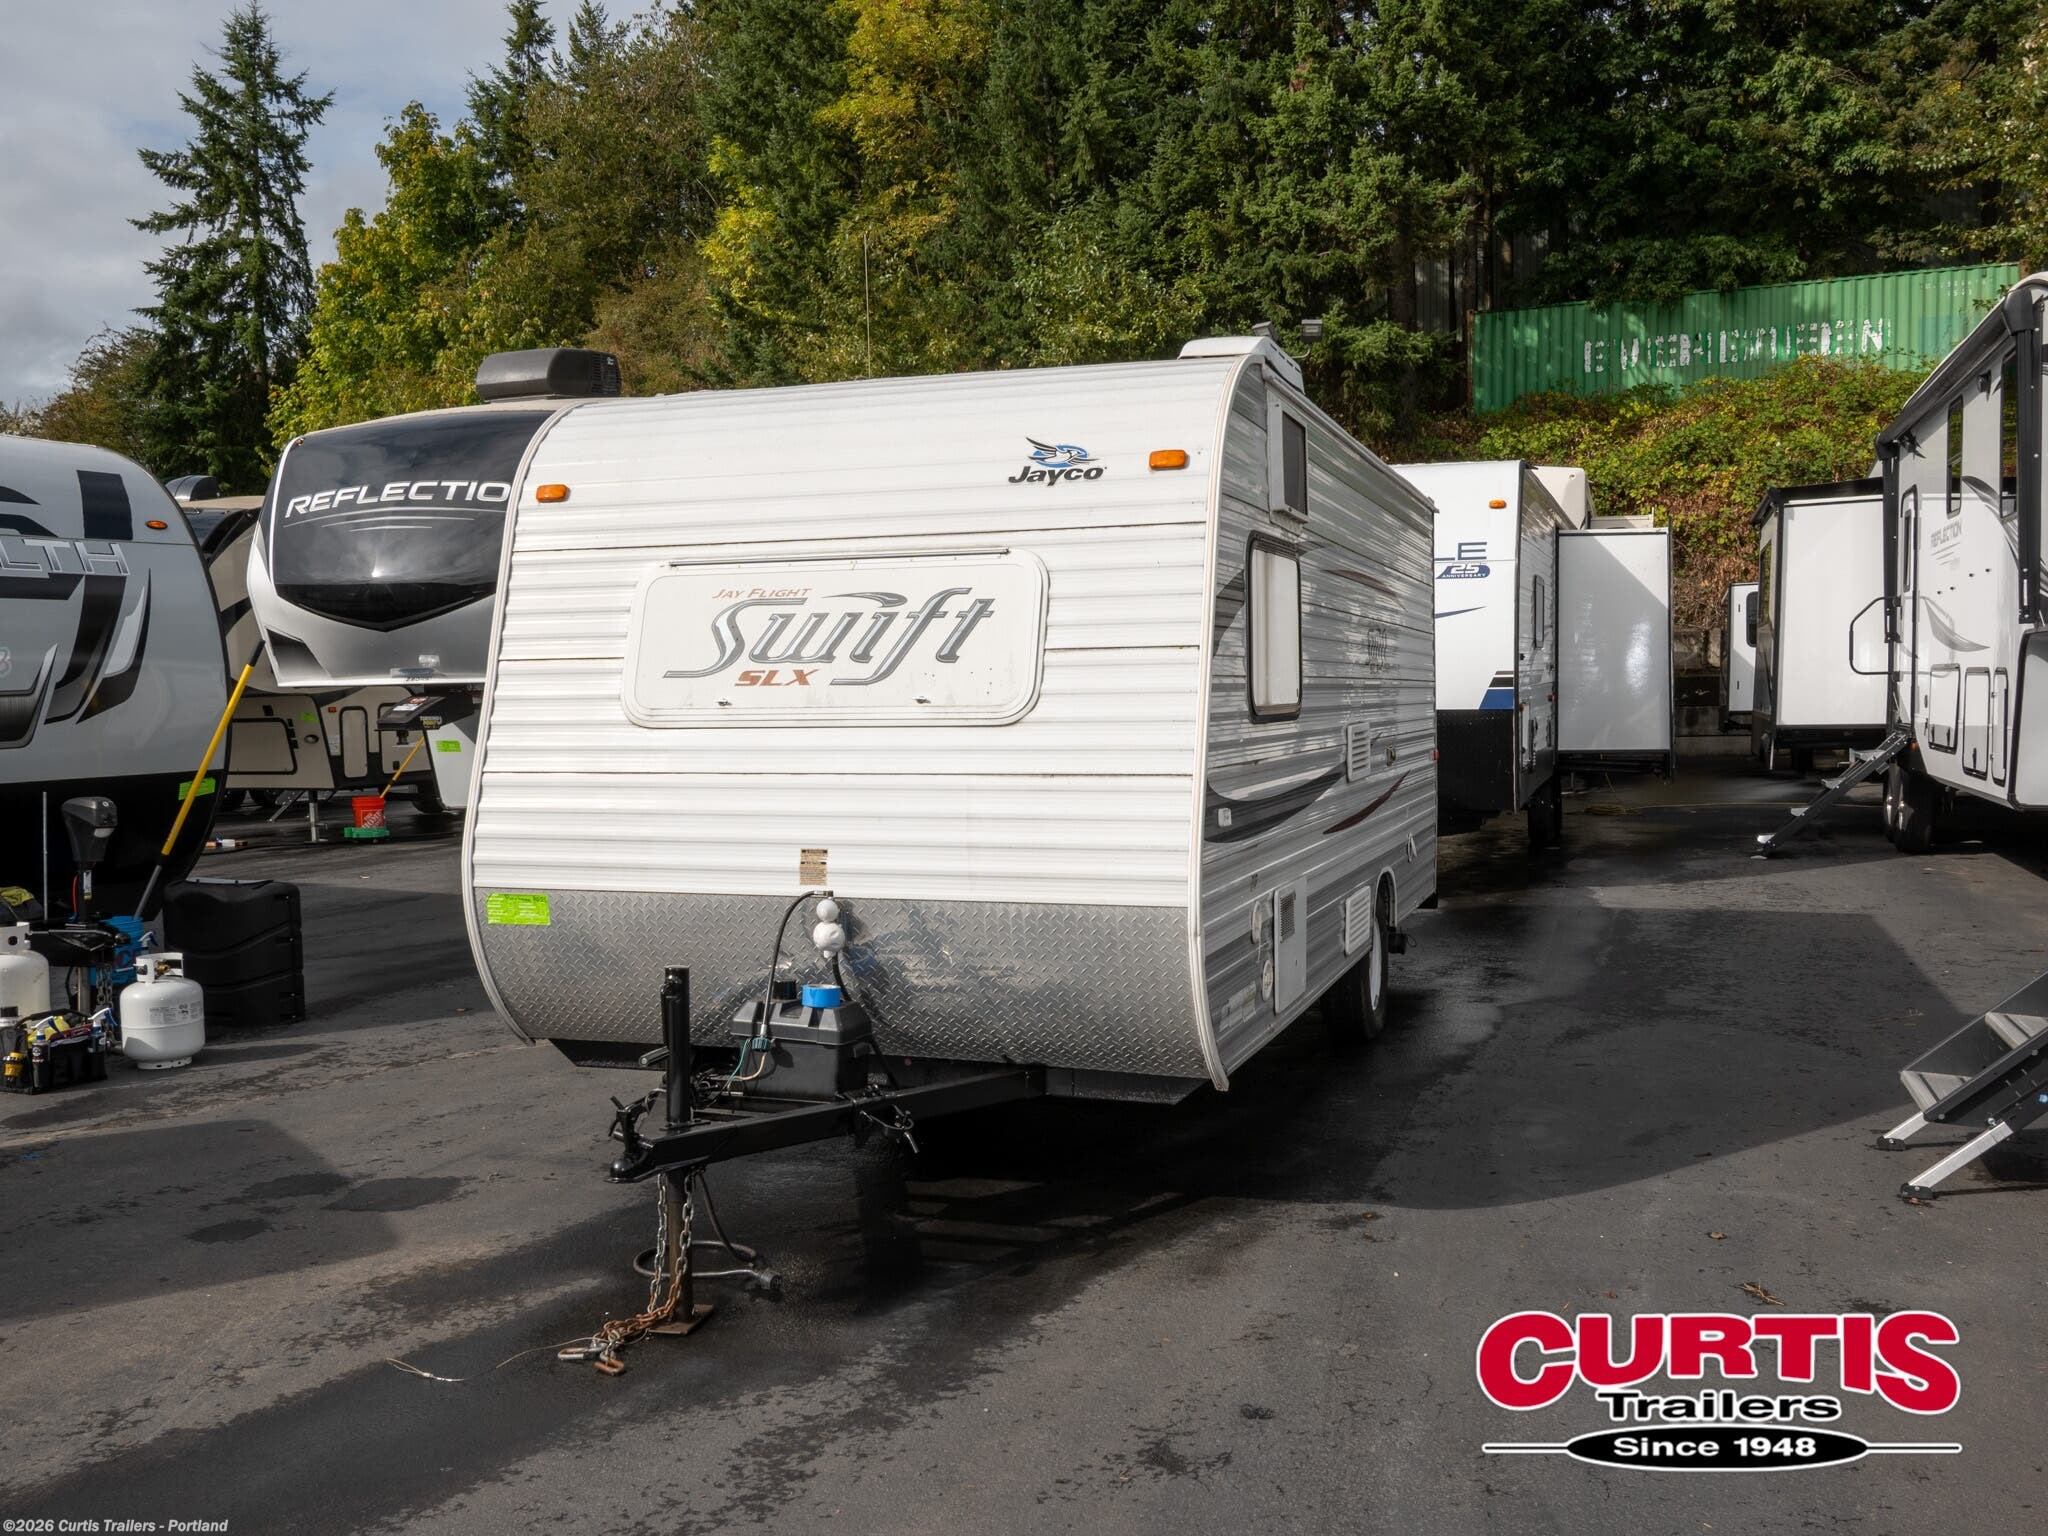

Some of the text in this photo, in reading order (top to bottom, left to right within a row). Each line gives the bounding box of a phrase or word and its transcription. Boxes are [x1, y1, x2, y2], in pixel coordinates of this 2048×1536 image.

[1008, 466, 1104, 486] Jayco
[1450, 563, 1480, 573] 25
[711, 588, 813, 599] JAY FLIGHT
[662, 587, 996, 686] Swift
[734, 668, 820, 687] SLX
